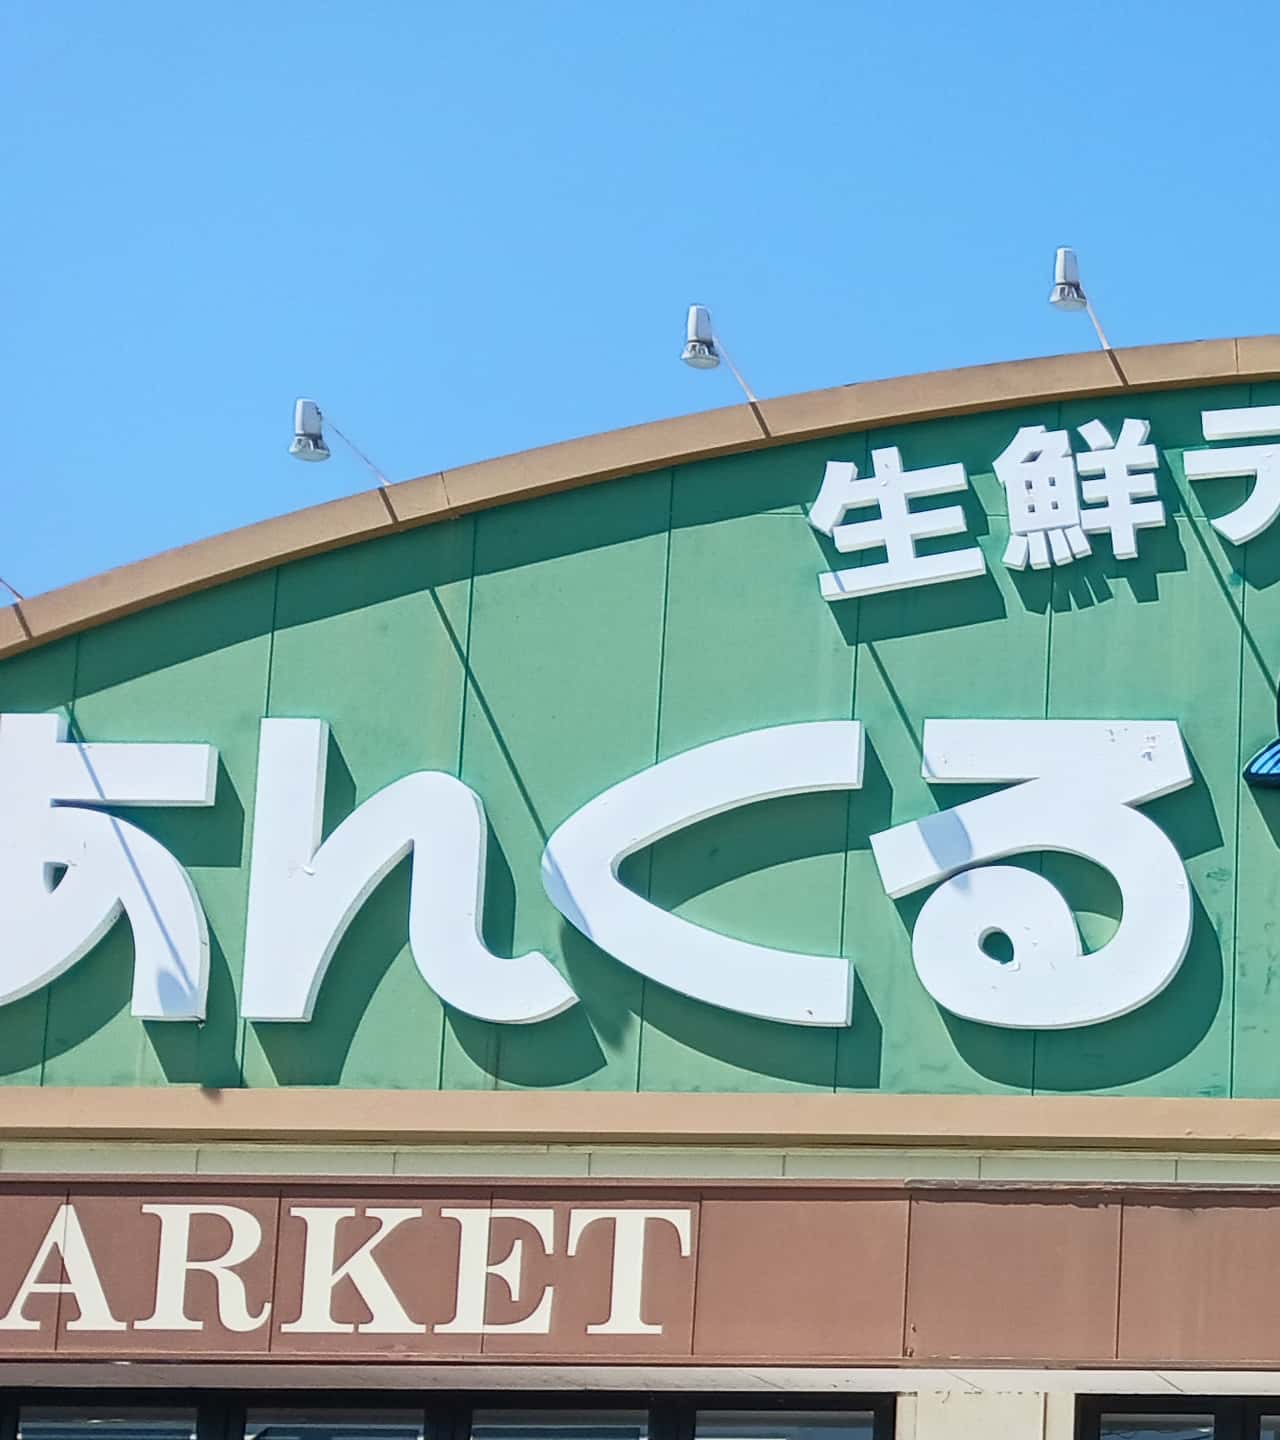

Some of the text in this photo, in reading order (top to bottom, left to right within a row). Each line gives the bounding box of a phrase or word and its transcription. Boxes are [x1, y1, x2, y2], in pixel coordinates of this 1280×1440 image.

[0, 712, 1195, 1030] あんくる
[0, 1203, 692, 1336] ARKET
